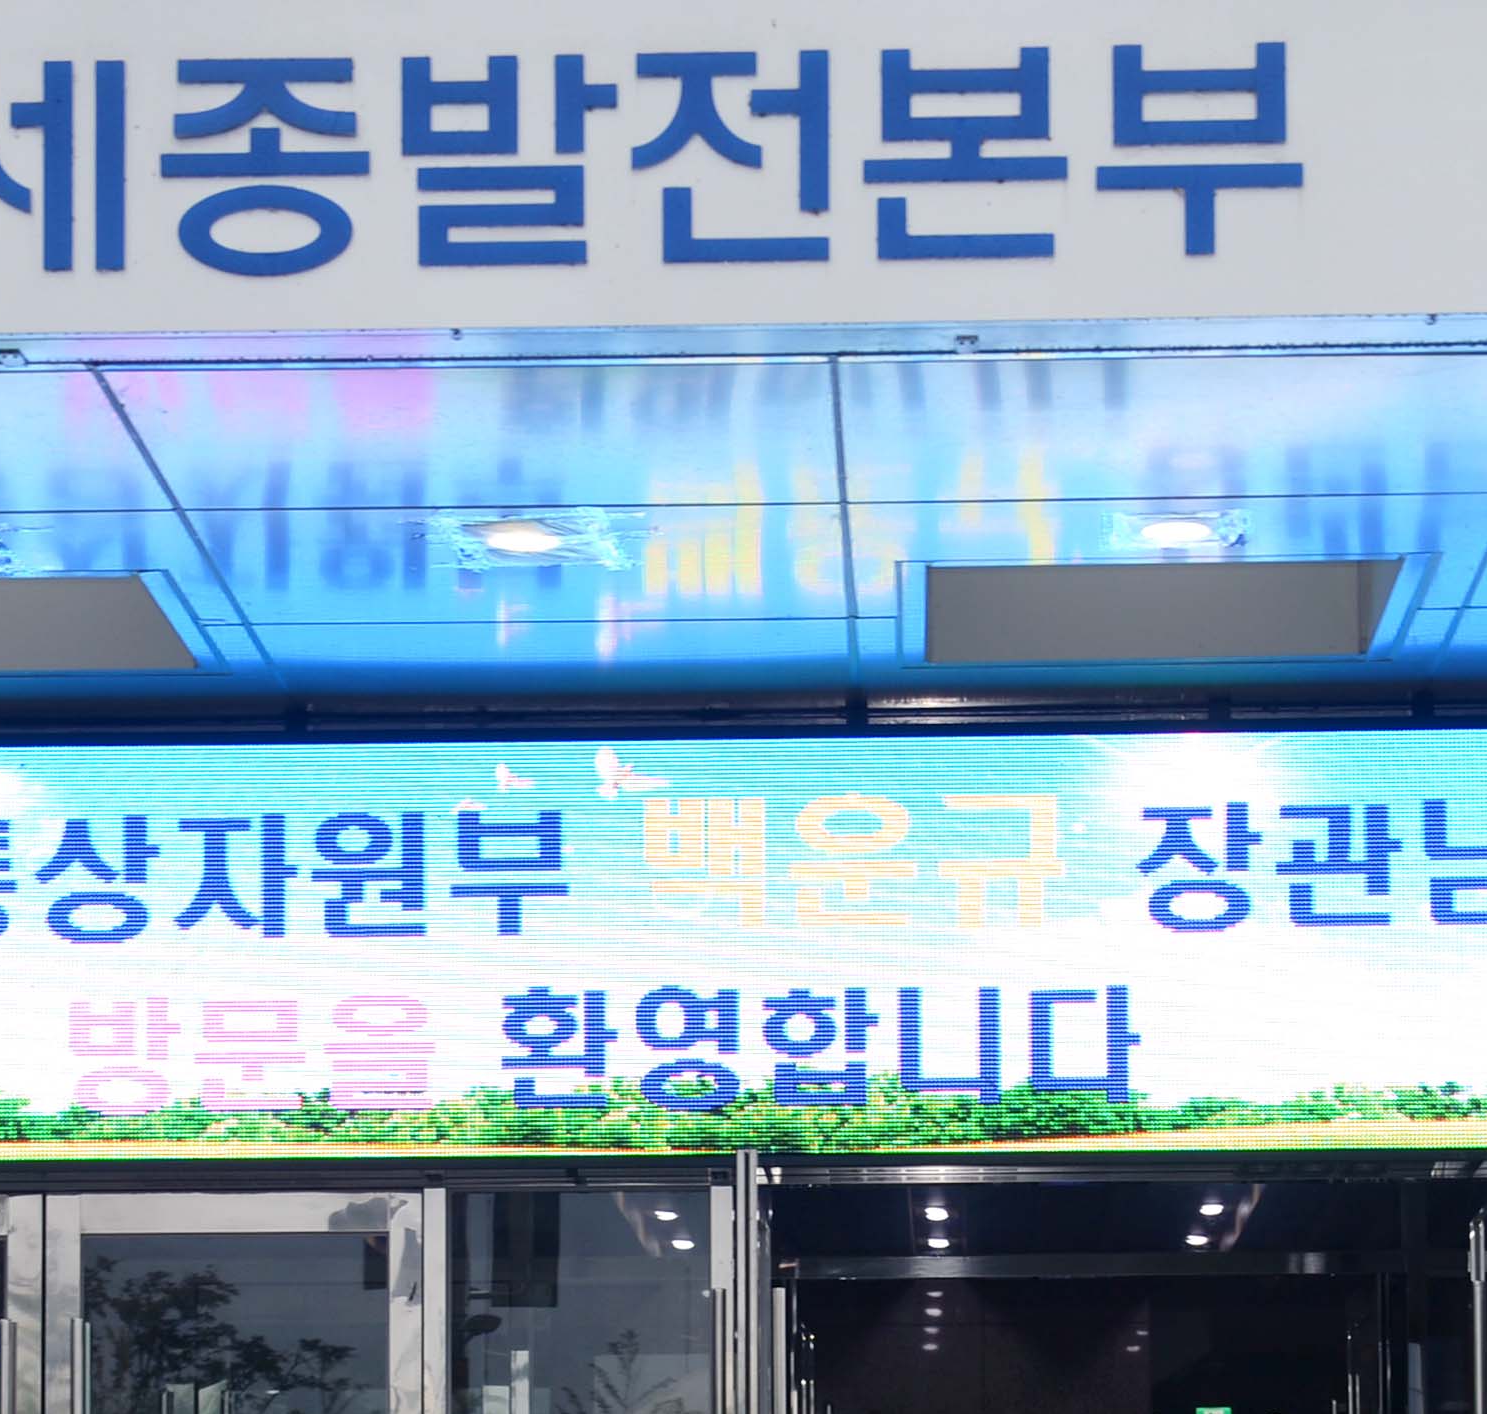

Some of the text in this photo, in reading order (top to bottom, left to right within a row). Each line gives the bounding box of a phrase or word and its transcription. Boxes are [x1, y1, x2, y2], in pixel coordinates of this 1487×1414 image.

[643, 794, 1066, 928] 백운규
[69, 985, 1141, 1116] 방문을 환영합니다
